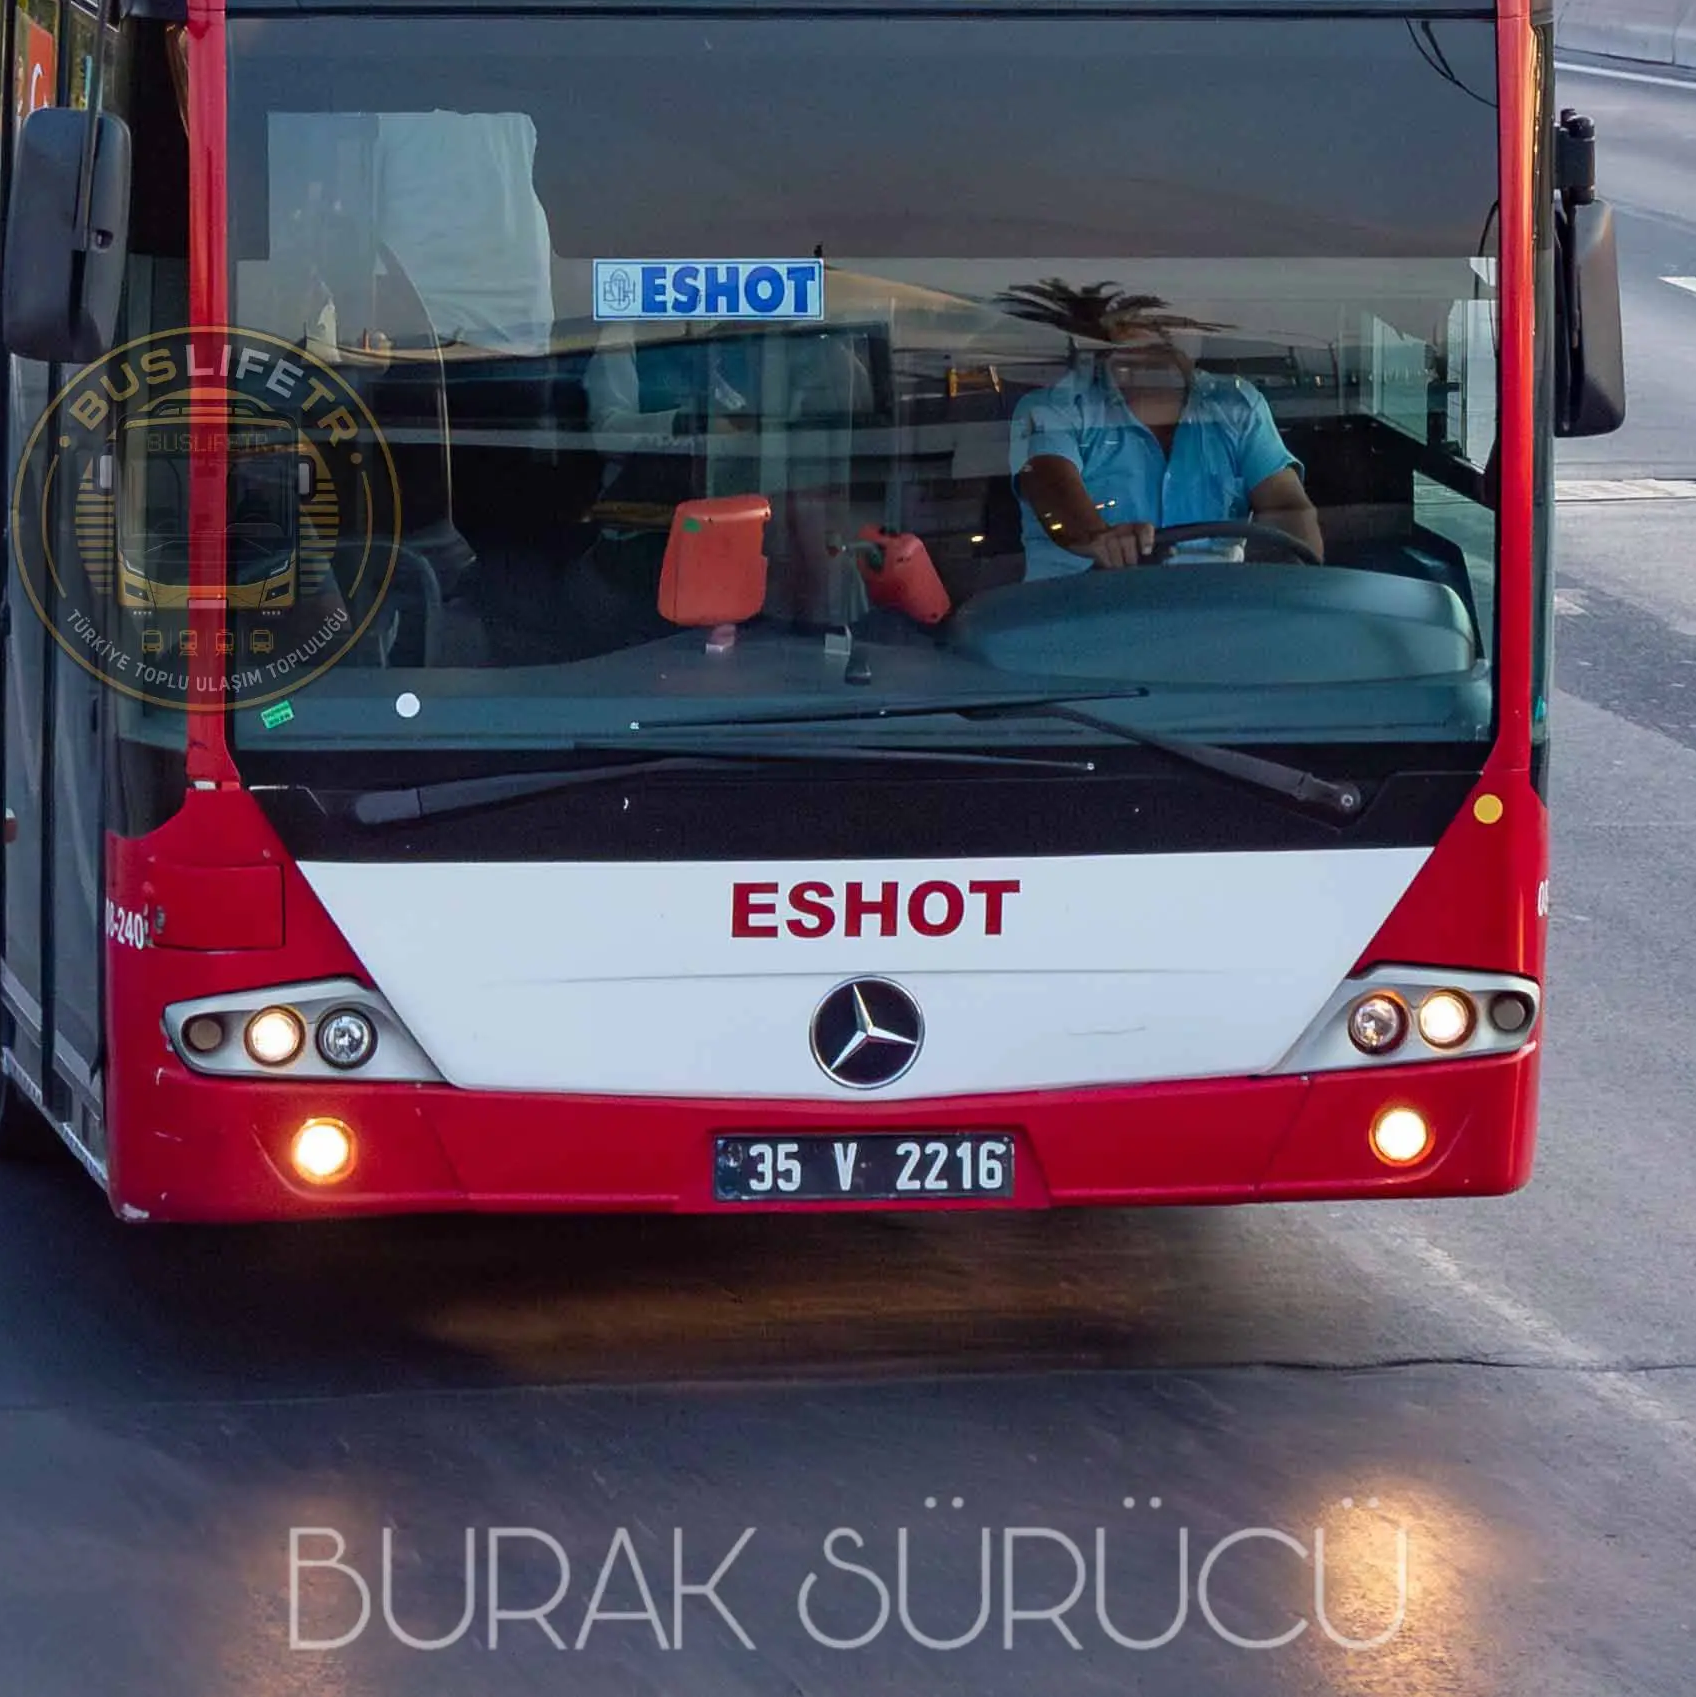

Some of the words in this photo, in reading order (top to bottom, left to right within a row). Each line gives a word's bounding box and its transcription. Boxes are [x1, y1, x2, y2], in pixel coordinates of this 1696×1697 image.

[641, 265, 816, 313] ESHOT
[731, 880, 1020, 939] ESHOT
[749, 1143, 801, 1192] 35
[832, 1142, 857, 1191] V
[895, 1141, 1007, 1191] 2216
